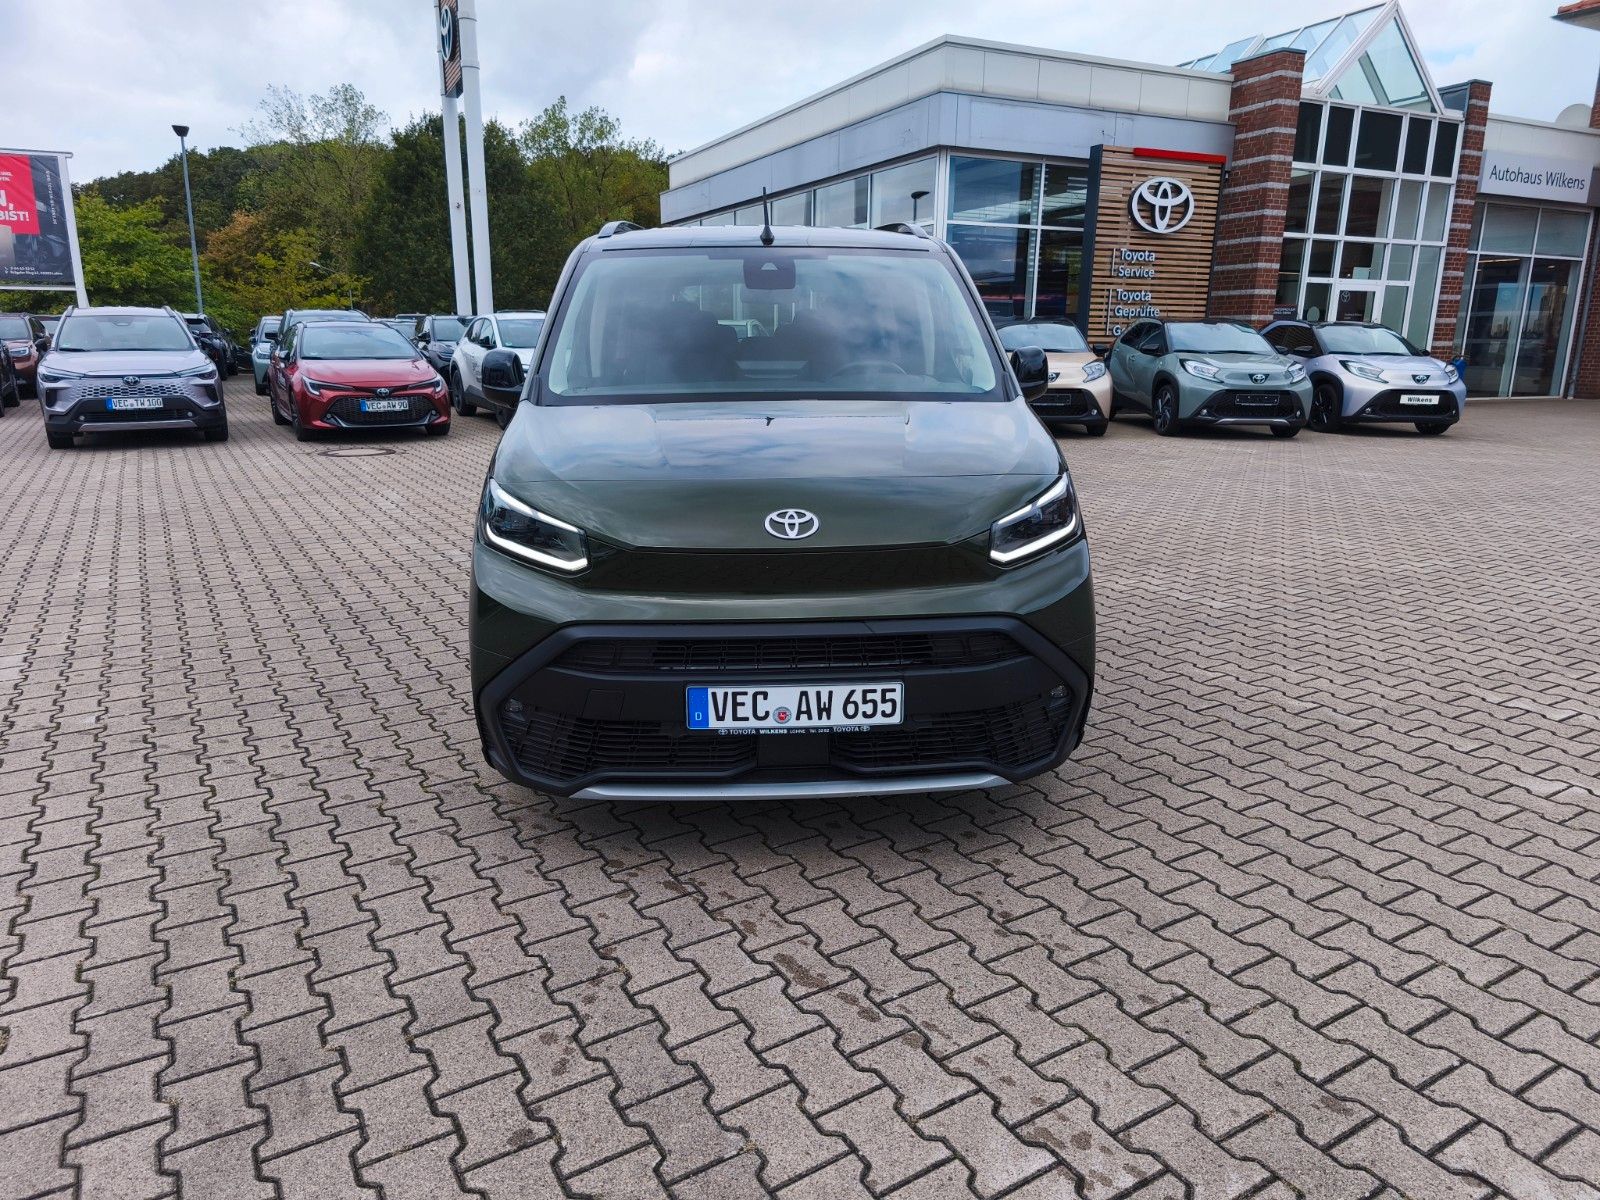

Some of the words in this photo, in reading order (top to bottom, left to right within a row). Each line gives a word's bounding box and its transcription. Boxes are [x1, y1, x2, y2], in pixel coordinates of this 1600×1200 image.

[1489, 164, 1542, 186] Autohaus
[1545, 171, 1586, 191] Wilkens
[1120, 248, 1156, 263] Toyota
[1118, 265, 1155, 277] Service
[1116, 288, 1152, 303] Toyota
[1114, 305, 1160, 319] Geprüfte
[112, 399, 128, 408] VEC
[134, 398, 145, 407] TW
[147, 398, 162, 407] 100
[366, 401, 381, 410] VEC
[387, 401, 397, 409] AW
[398, 400, 408, 409] 90
[711, 690, 770, 722] VEC
[795, 690, 834, 721] AW
[842, 688, 898, 720] 655
